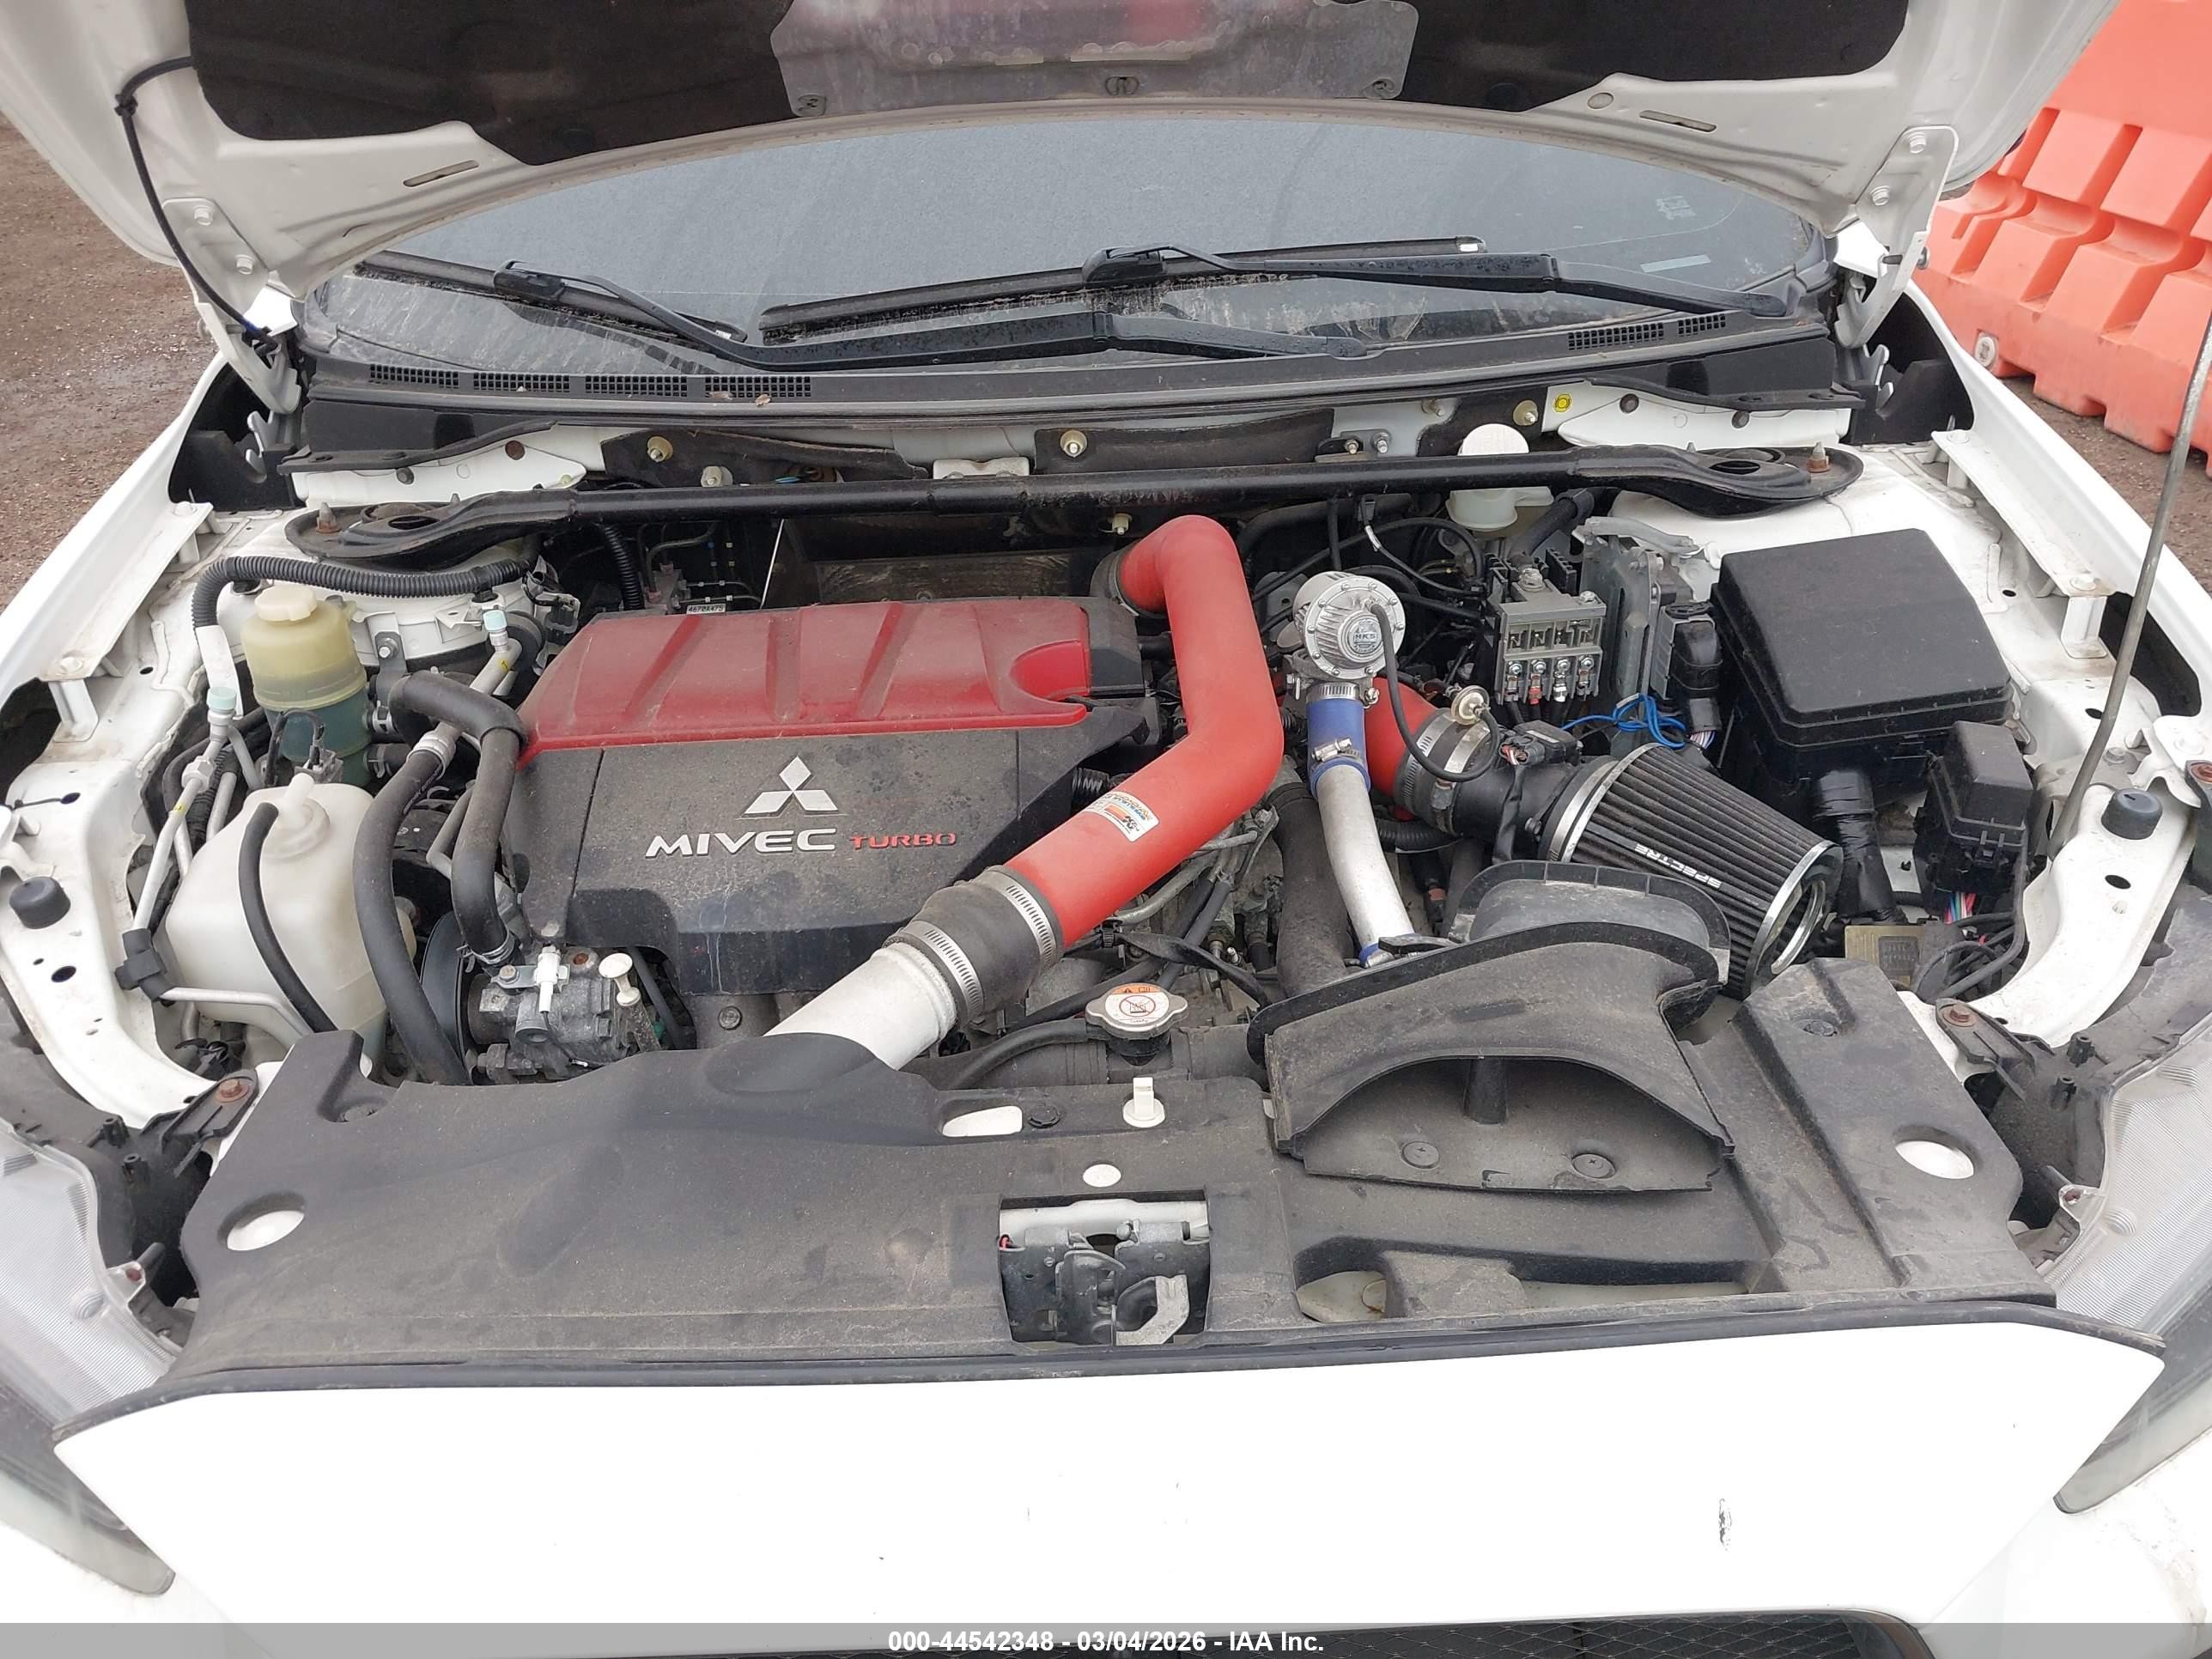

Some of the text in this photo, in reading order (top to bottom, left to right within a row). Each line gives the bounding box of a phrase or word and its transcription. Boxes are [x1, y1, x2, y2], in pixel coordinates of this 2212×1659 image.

[645, 828, 957, 857] MIVEC TURBO
[1634, 843, 1723, 890] SPECTRE
